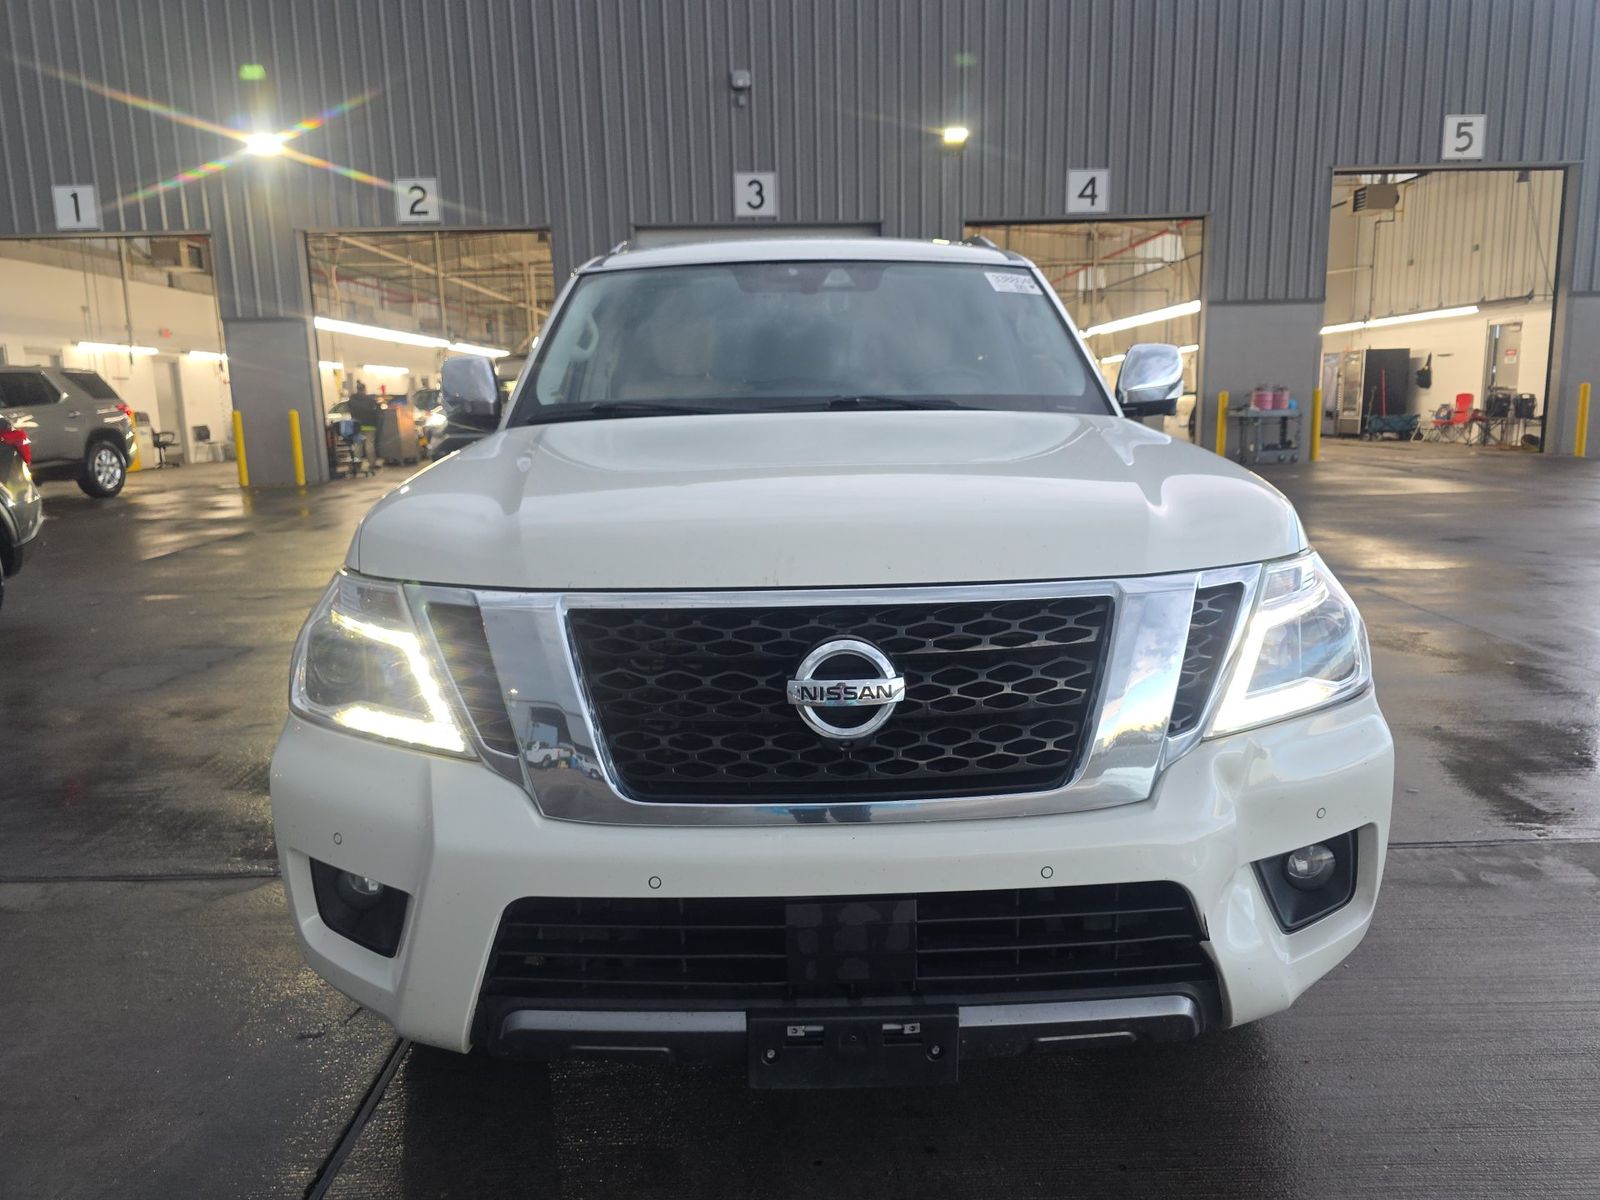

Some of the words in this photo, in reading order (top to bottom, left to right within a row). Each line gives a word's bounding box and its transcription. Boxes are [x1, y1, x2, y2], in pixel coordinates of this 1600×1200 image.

[1454, 122, 1473, 153] 5
[408, 185, 430, 216] 2
[746, 178, 766, 211] 3
[1076, 176, 1099, 207] 4
[70, 192, 81, 223] 1
[800, 685, 893, 701] NISSAN
